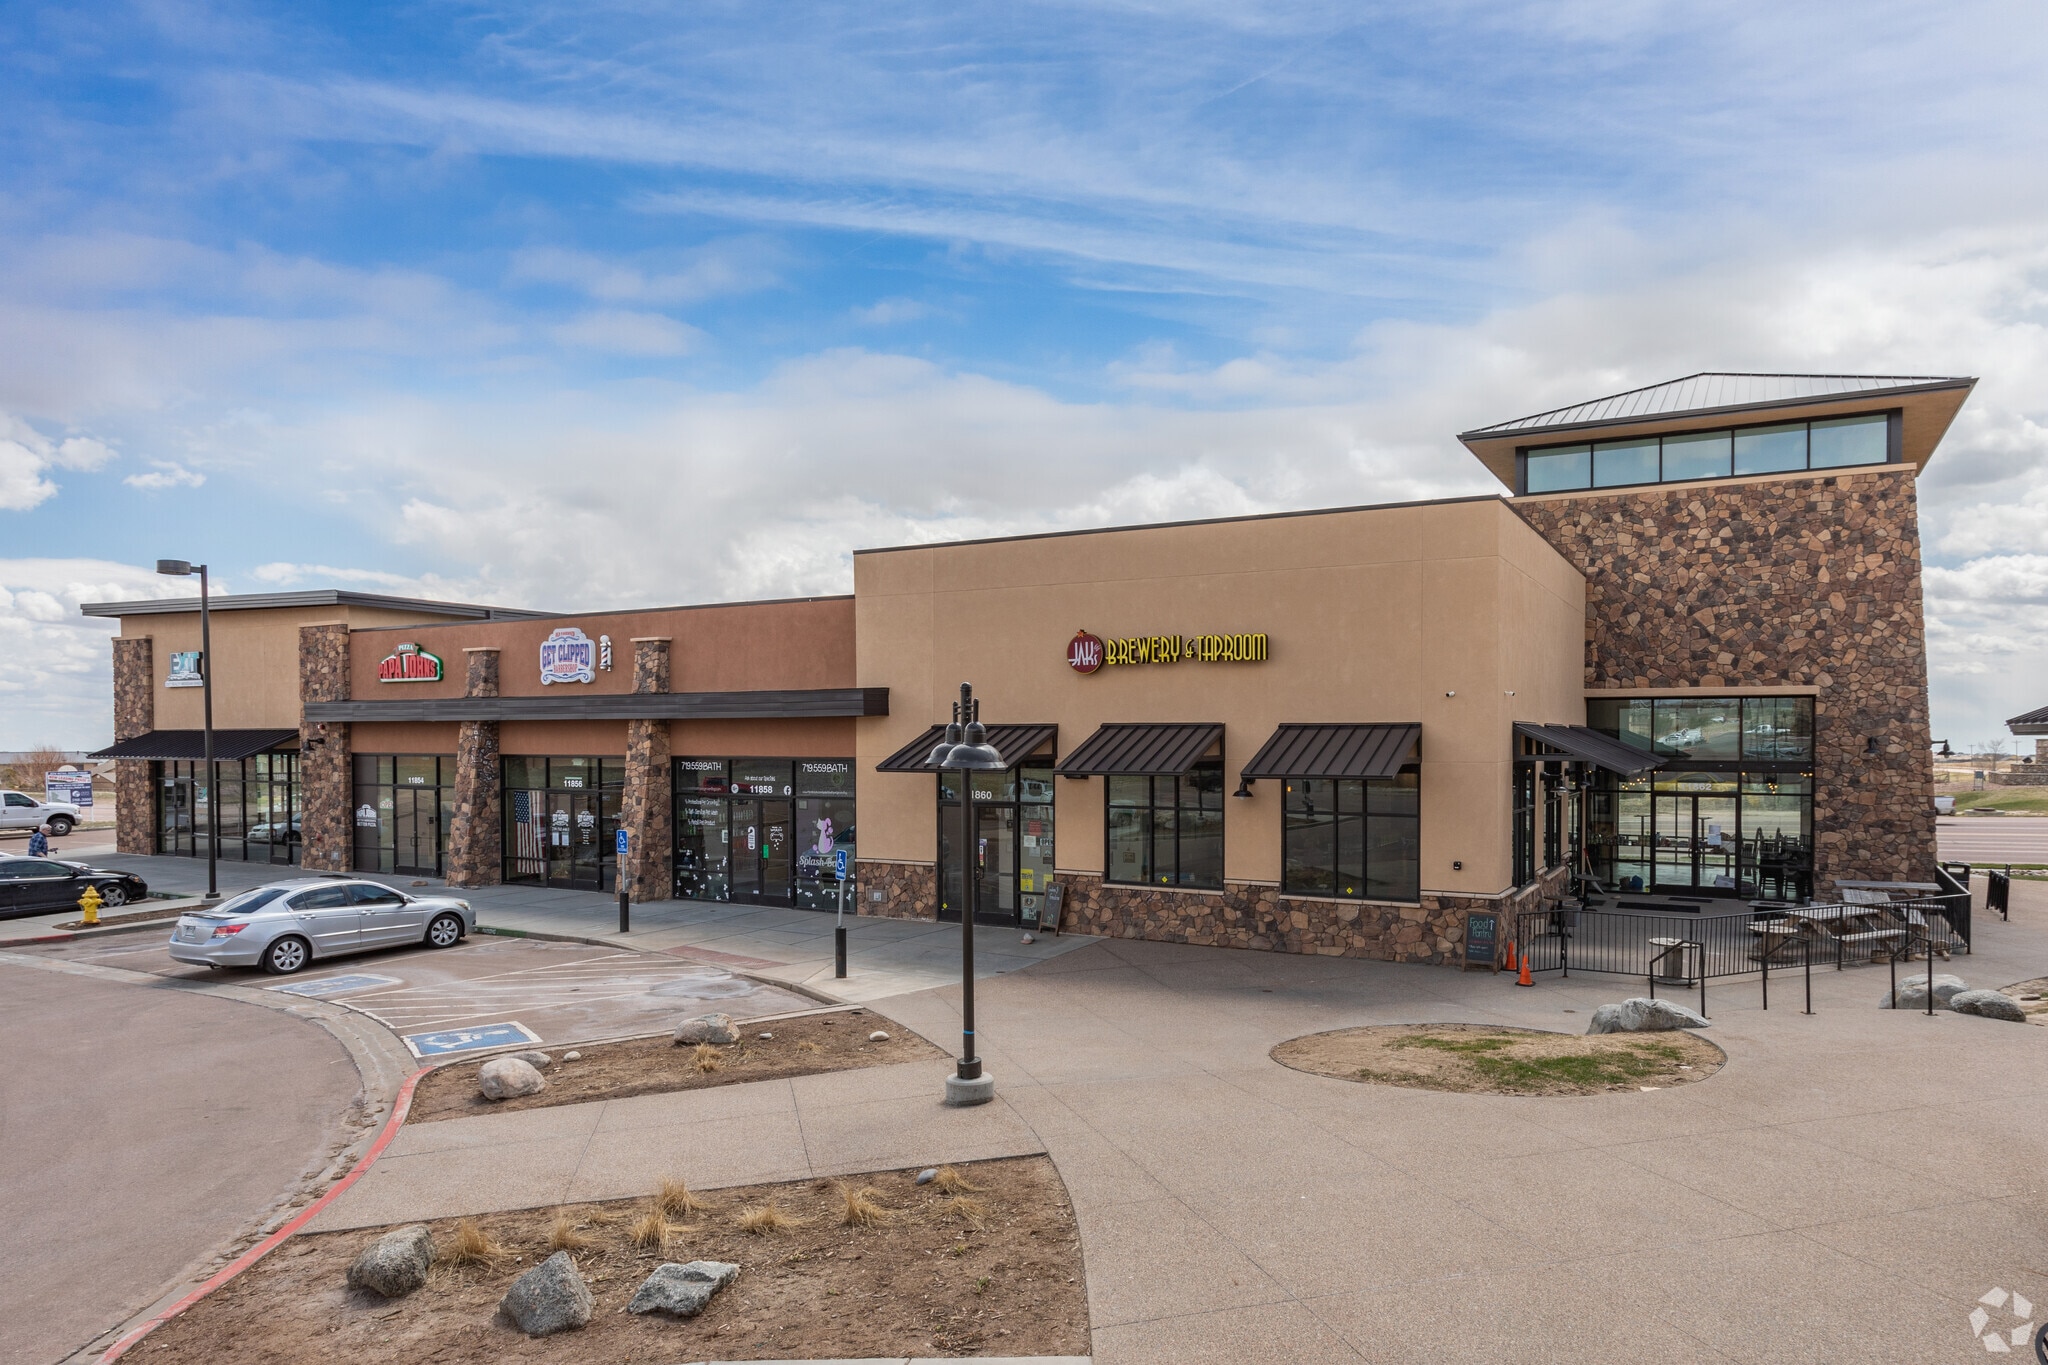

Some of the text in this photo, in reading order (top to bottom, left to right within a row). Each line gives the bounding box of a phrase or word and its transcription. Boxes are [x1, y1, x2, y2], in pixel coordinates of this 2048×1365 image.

[398, 643, 413, 651] PIZZA
[1106, 635, 1181, 665] BREWERY
[1185, 639, 1195, 658] &
[1196, 633, 1268, 662] TAPROOM
[542, 643, 590, 669] GET CLIPPED
[170, 651, 199, 674] EXIT
[378, 654, 436, 679] PAPA JOHNS
[563, 780, 583, 788] 11856
[749, 785, 773, 793] 11858
[1470, 917, 1489, 929] Food
[1472, 928, 1492, 939] Pantry
